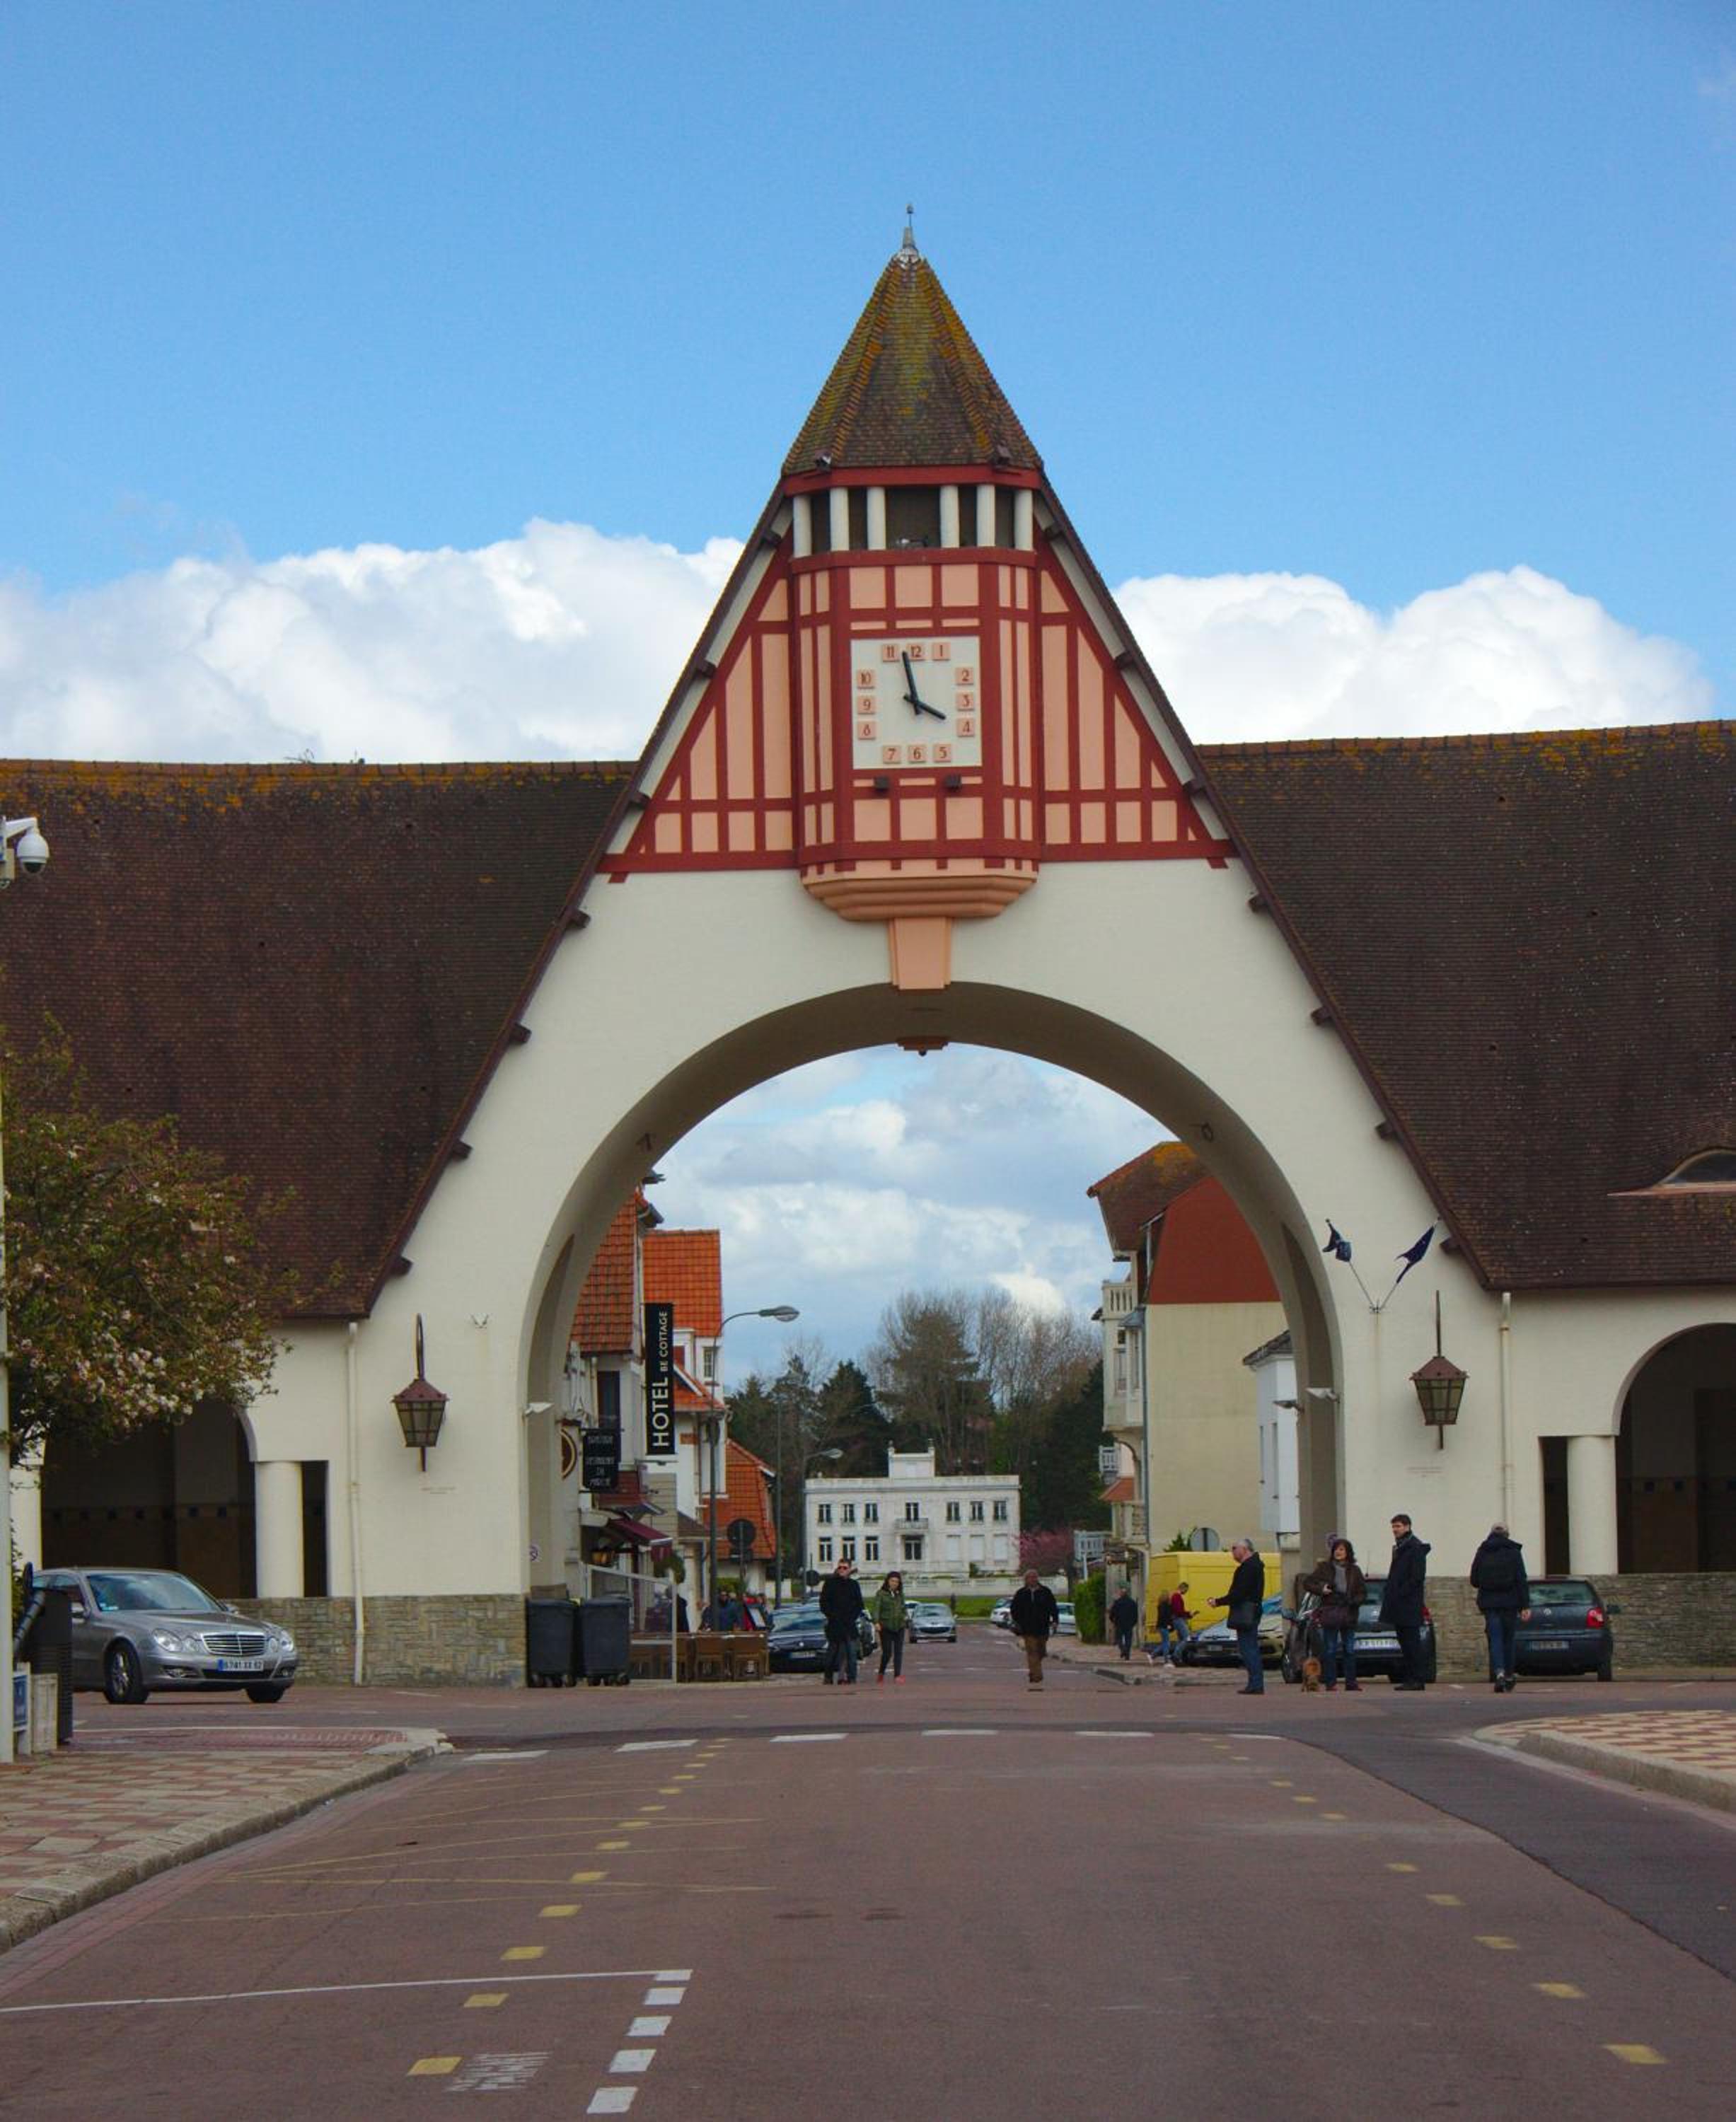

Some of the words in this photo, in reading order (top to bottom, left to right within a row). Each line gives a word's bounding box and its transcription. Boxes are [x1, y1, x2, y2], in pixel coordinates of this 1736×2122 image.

[886, 645, 895, 659] 11
[910, 644, 922, 658] 12
[861, 672, 872, 686] 10
[961, 669, 970, 682] 2
[863, 698, 871, 711] 9
[962, 694, 970, 707] 3
[962, 720, 970, 733] 4
[887, 748, 896, 760] 7
[913, 747, 922, 760] 6
[939, 746, 947, 759] 5
[659, 1311, 669, 1357] COTTAGE
[652, 1376, 669, 1446] HOTEL
